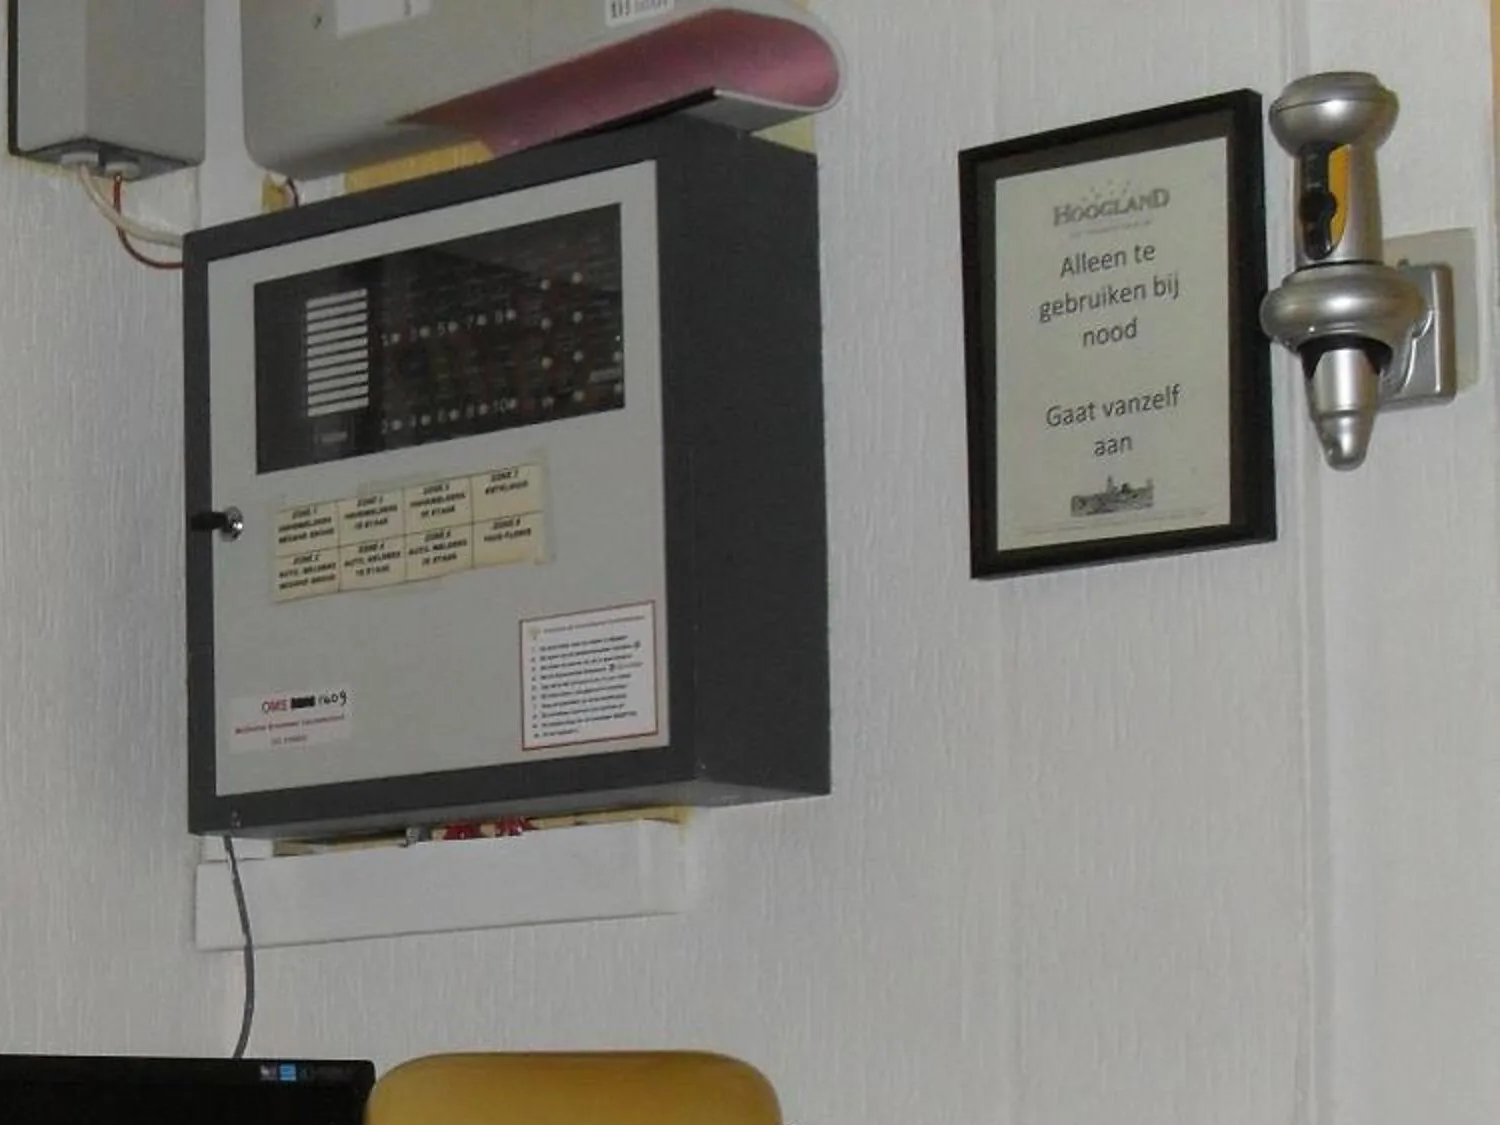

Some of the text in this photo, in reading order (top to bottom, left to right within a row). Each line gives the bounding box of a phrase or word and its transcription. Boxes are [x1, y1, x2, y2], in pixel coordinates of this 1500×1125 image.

[1059, 243, 1157, 279] Alleen te
[1038, 273, 1181, 324] gebruiken bij
[1082, 316, 1138, 349] nood
[1045, 383, 1181, 429] Gaat vanzelf
[1093, 434, 1133, 458] aan
